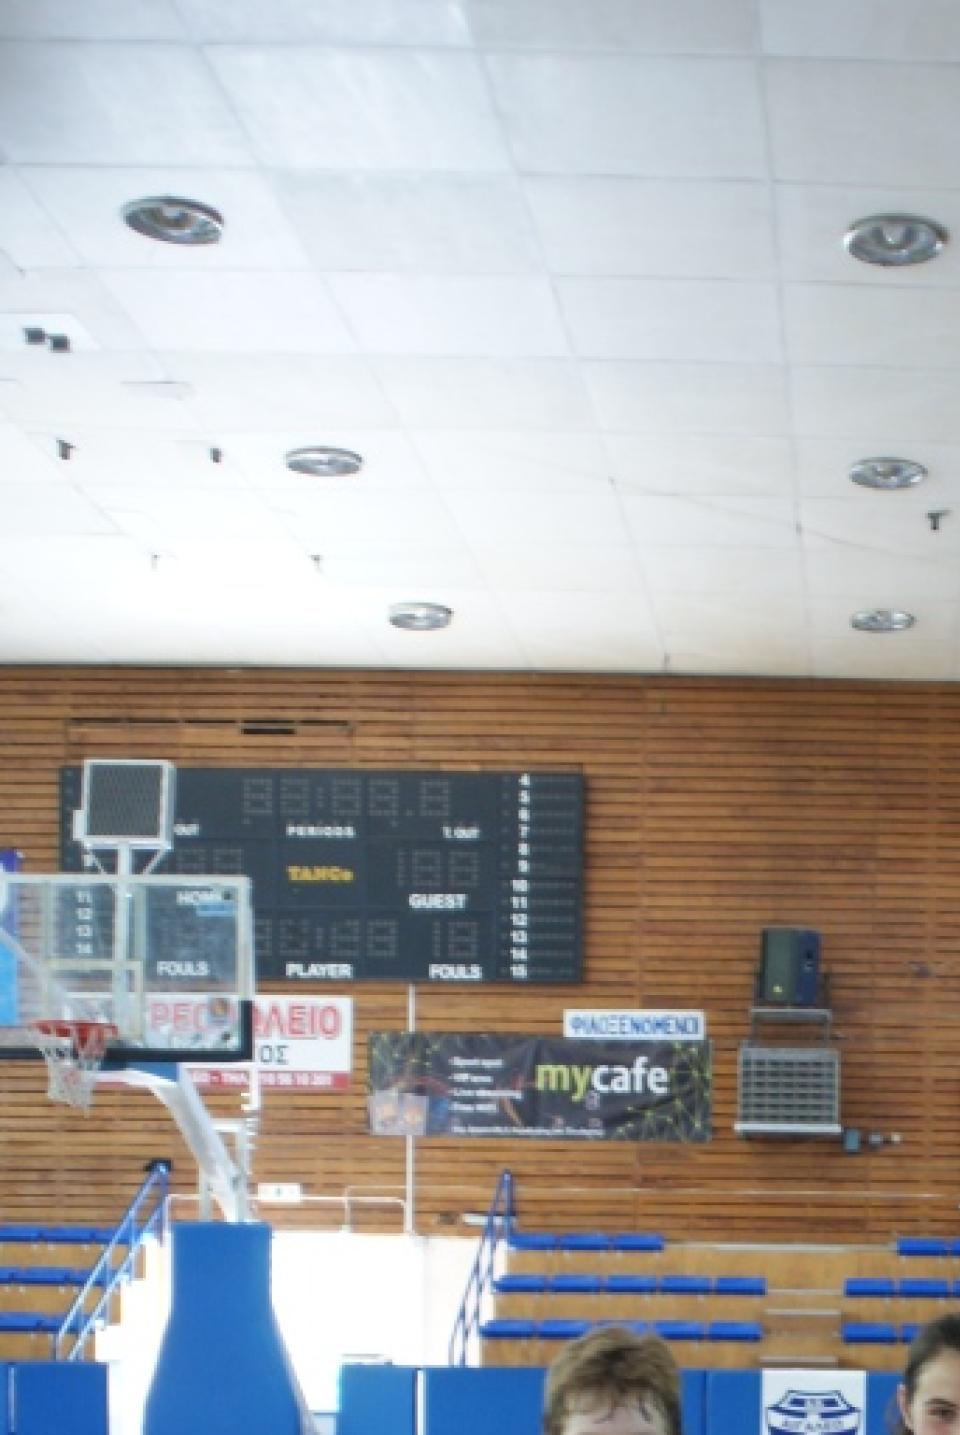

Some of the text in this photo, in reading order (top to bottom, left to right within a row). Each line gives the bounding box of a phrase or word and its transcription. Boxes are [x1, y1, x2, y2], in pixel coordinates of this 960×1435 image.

[286, 826, 356, 839] PERIODS
[408, 893, 467, 910] GUEST
[156, 960, 209, 977] FOULS
[286, 963, 354, 978] PLAYER
[428, 963, 483, 979] FOULS
[535, 1056, 669, 1103] mycafe
